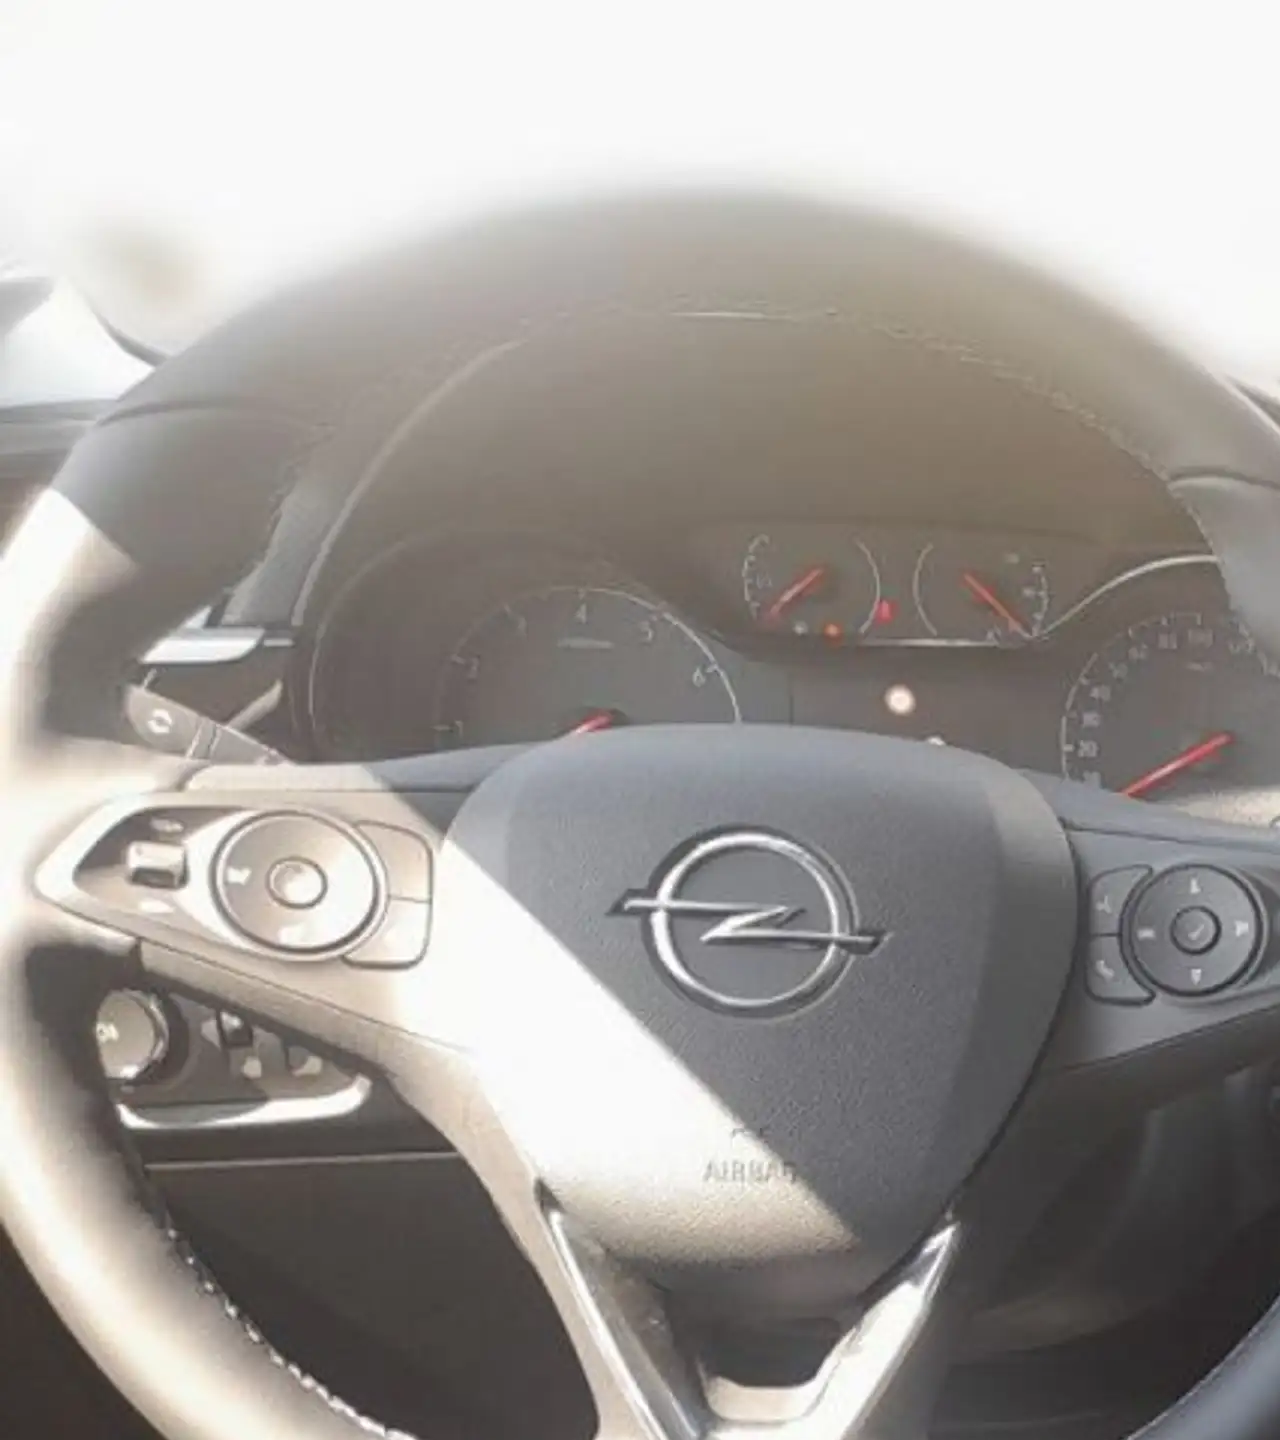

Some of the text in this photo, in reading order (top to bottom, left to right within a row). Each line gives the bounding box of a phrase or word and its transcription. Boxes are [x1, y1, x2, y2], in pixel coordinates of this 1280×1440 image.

[574, 602, 587, 624] 4
[692, 667, 706, 687] 6
[1078, 741, 1098, 757] 20
